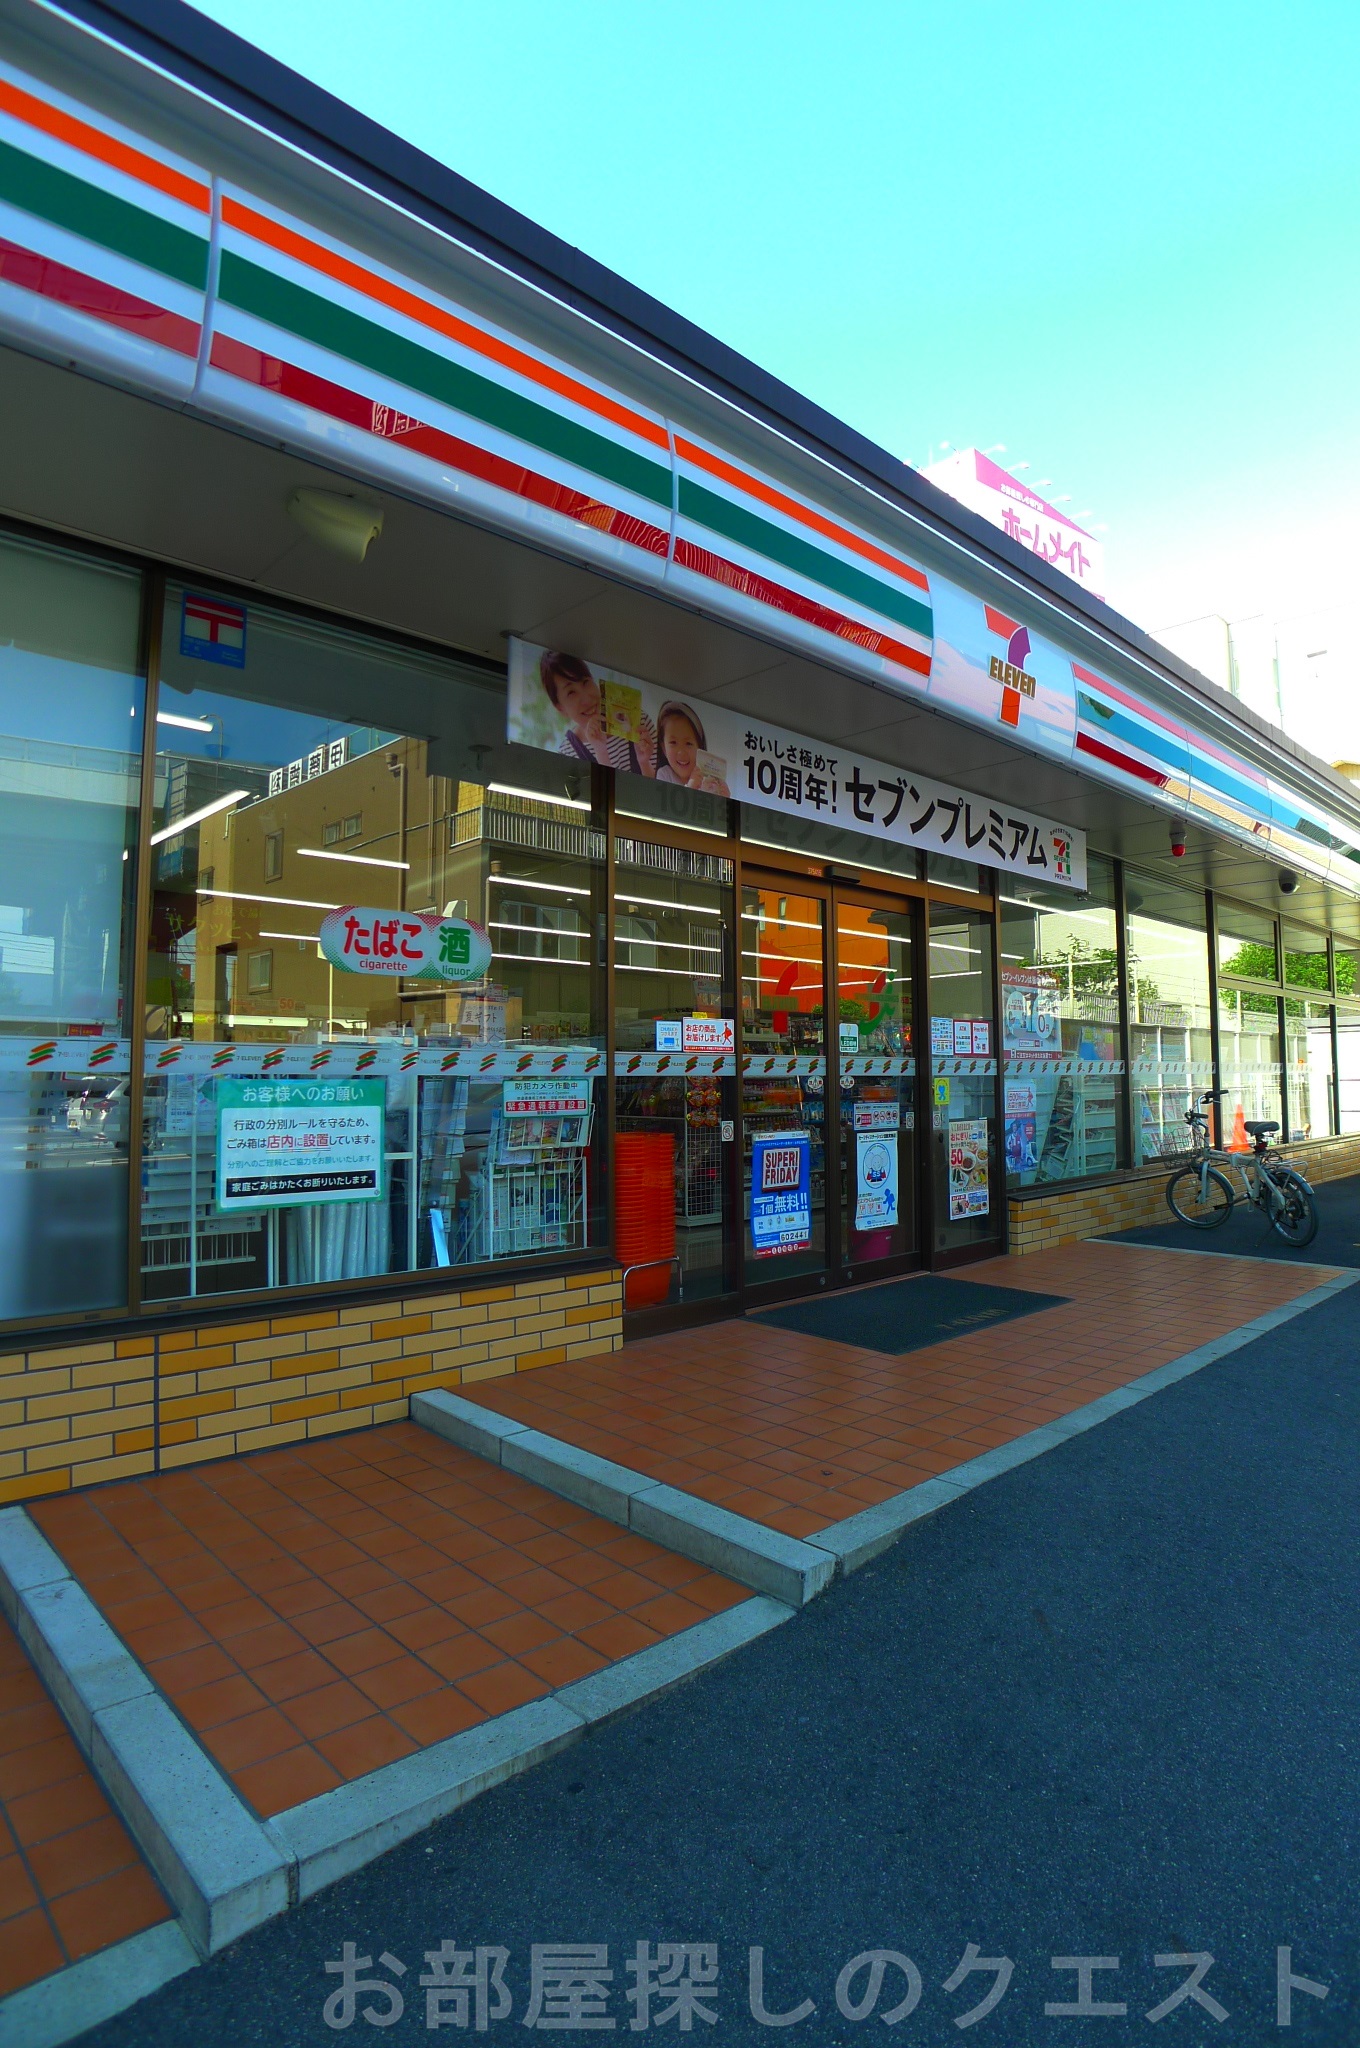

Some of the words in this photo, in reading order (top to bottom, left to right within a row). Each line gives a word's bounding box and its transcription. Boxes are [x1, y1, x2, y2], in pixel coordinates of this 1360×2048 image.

[1002, 507, 1091, 577] ホームメイト
[989, 656, 1036, 699] ELEVEN
[744, 730, 838, 776] おいしさ極めて
[743, 756, 837, 814] 10周年!
[845, 766, 1048, 869] セブンプレミアム
[343, 915, 423, 959] たばこ
[438, 925, 471, 964] 酒
[359, 959, 408, 972] cigarette
[442, 965, 471, 976] liquor
[686, 1024, 716, 1033] お店の商品
[243, 1086, 364, 1102] お客様へのお願い
[515, 1082, 578, 1090] 防犯カメラ作動中
[234, 1118, 369, 1131] 行政の分別ルールを守るため、
[227, 1134, 376, 1149] ごみ箱は店内に設置しています。
[227, 1155, 375, 1169] 分別へのご理解とご協力をお願いいたします。
[232, 1175, 373, 1192] 家庭ごみはかたくお断りいたします。
[765, 1167, 798, 1185] FRIDAY
